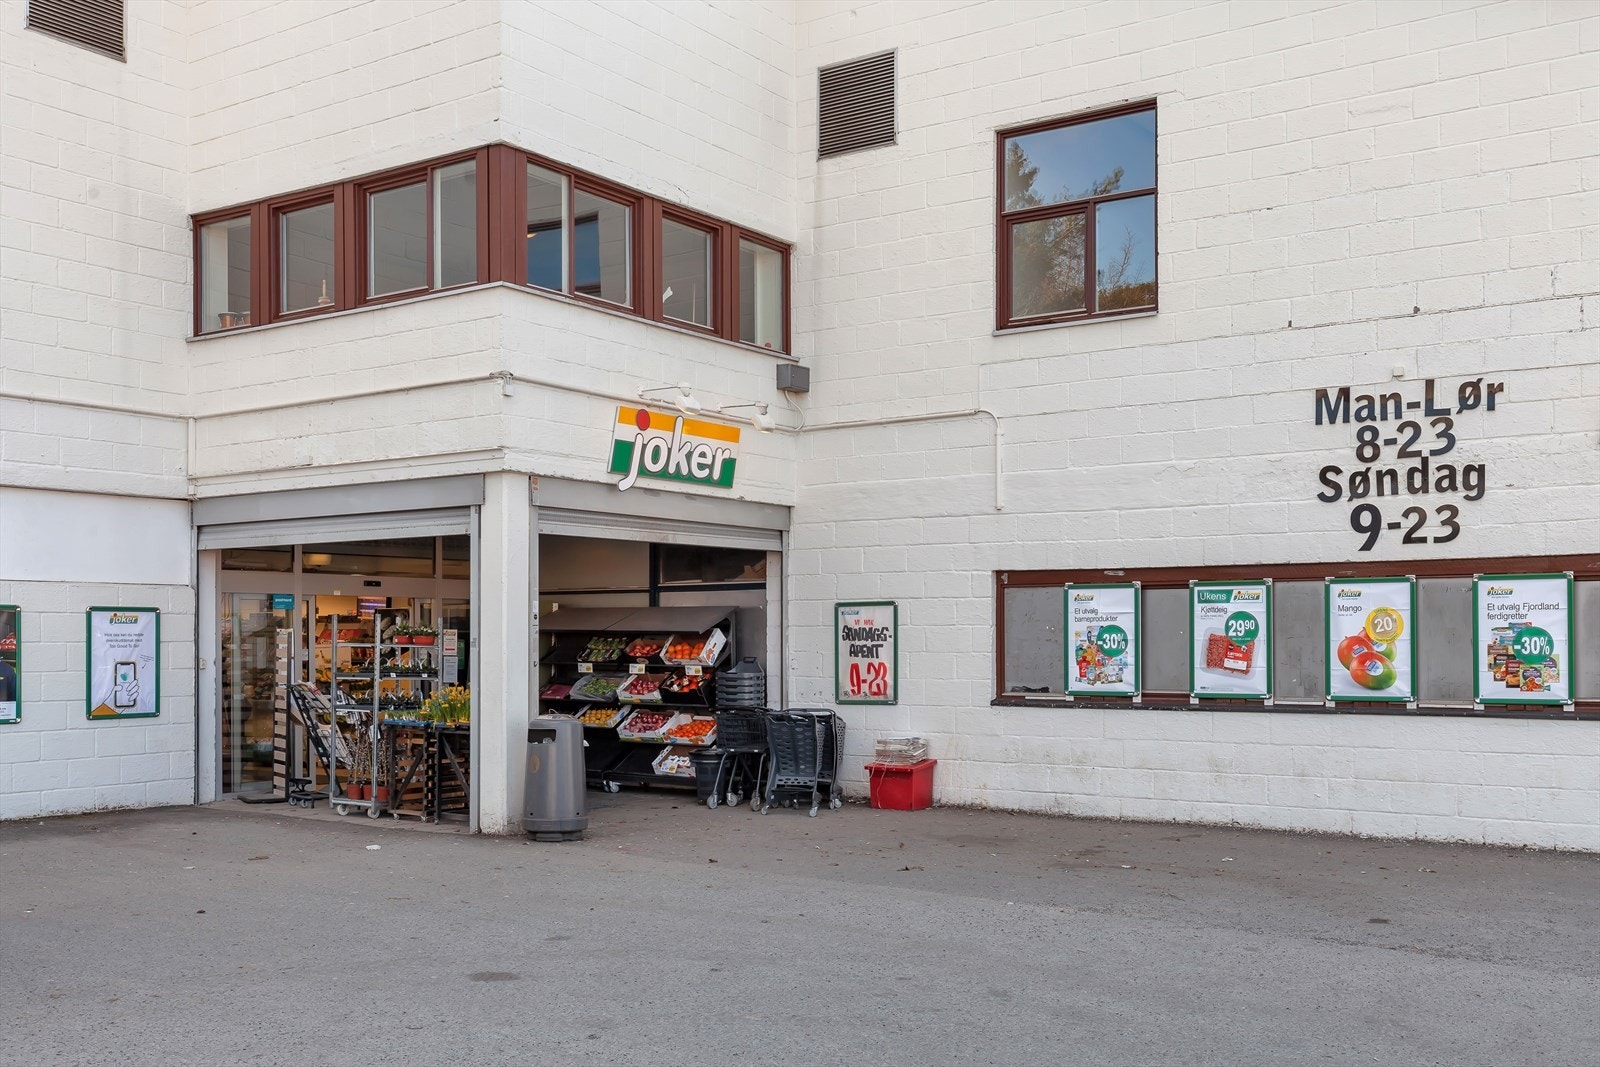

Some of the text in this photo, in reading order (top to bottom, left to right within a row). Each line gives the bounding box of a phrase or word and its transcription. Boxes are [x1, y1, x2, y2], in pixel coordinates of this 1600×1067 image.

[1315, 377, 1504, 425] Man-Lør
[1356, 416, 1456, 463] 8-23
[618, 409, 731, 491] joker
[1317, 456, 1485, 503] Søndag
[1350, 503, 1460, 551] 9-23
[1199, 591, 1260, 602] Ukens joker
[1338, 589, 1361, 598] joker
[1487, 586, 1513, 596] joker
[1081, 608, 1099, 616] utvalg
[1337, 604, 1362, 613] Mango
[1487, 603, 1560, 612] Et utvalg Fjordland
[111, 613, 137, 625] joker
[1487, 613, 1528, 621] ferdigretter
[1374, 617, 1393, 633] 20
[1097, 634, 1126, 649] -30%
[1513, 636, 1550, 655] -30%
